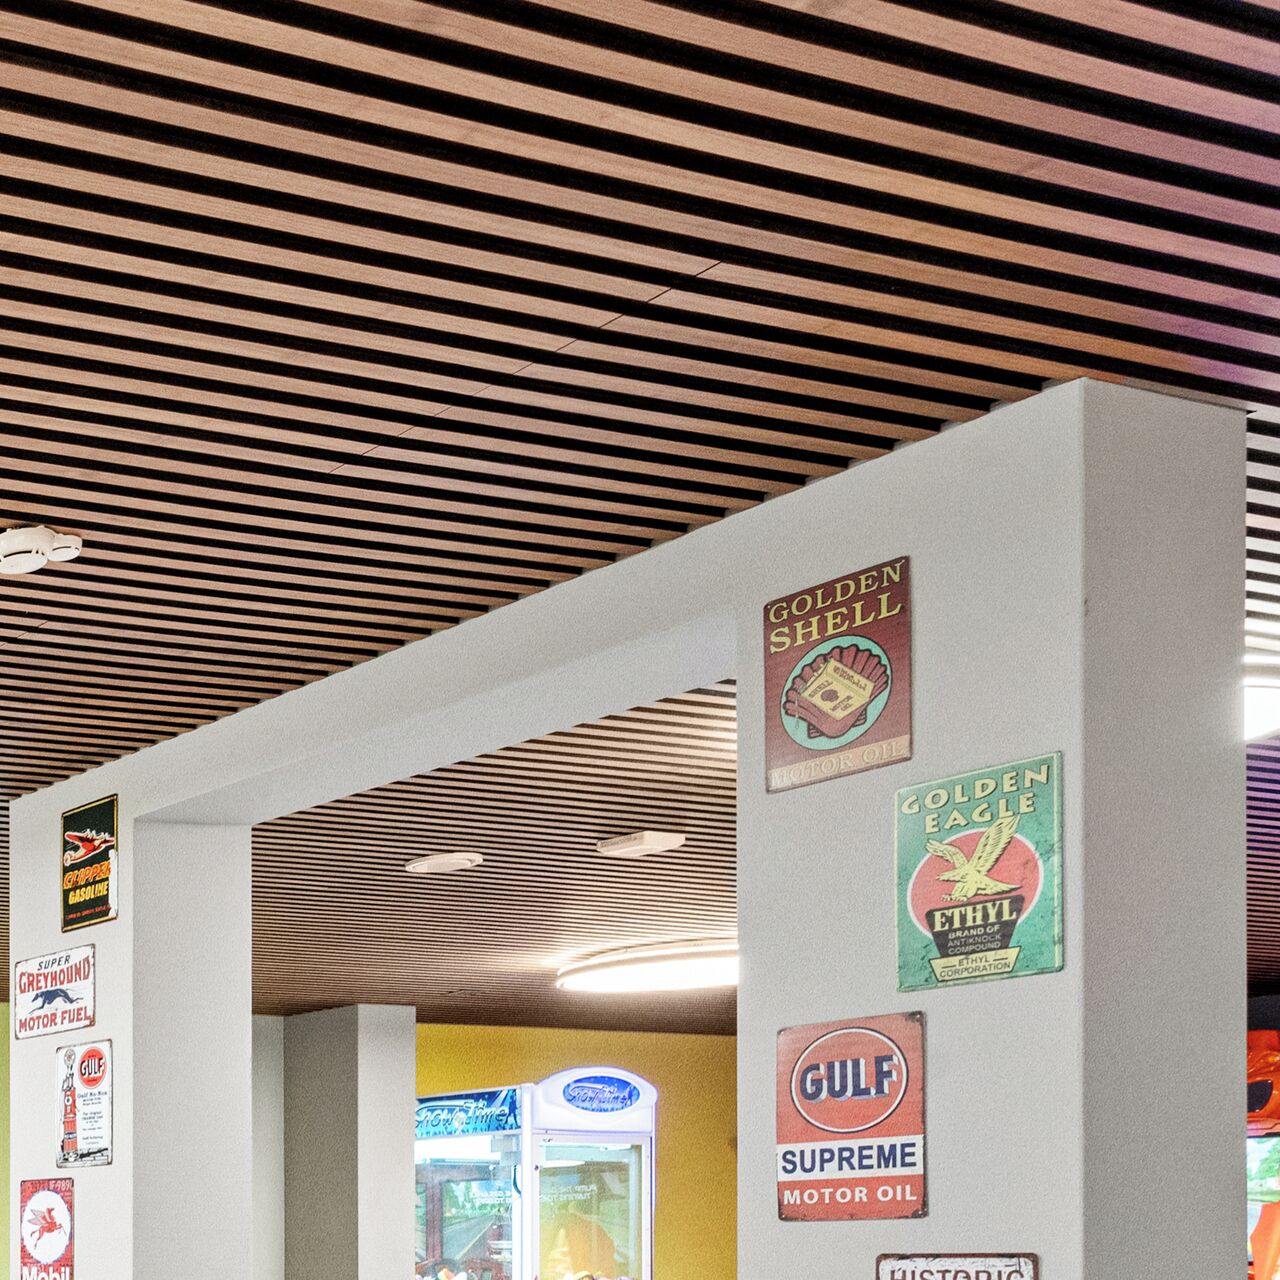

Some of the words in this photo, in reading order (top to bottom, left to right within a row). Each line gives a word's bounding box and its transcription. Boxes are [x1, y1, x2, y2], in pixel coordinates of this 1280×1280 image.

[768, 558, 906, 624] GOLDEN
[769, 592, 903, 654] SHELL
[770, 752, 856, 789] MOTOR
[861, 740, 905, 765] OIL
[900, 763, 1050, 815] GOLDEN
[925, 792, 1036, 834] EAGLE
[68, 881, 109, 905] GASOLINE
[933, 898, 1017, 932] ETHYL
[948, 926, 985, 940] BRAND
[986, 924, 1001, 934] OF
[948, 933, 1002, 948] ANTIKNOCK
[948, 941, 1001, 955] COMPOUND
[958, 954, 990, 967] ETHYL
[18, 955, 91, 995] GREYHOUND
[37, 954, 71, 972] SUPER
[940, 961, 1011, 978] CORPORATION
[18, 1011, 58, 1034] MOTOR
[60, 1005, 92, 1026] FUEL
[80, 1056, 105, 1077] GULF
[799, 1053, 900, 1102] GULF
[781, 1142, 917, 1175] SUPREME
[783, 1186, 868, 1206] MOTOR
[876, 1184, 918, 1202] OIL
